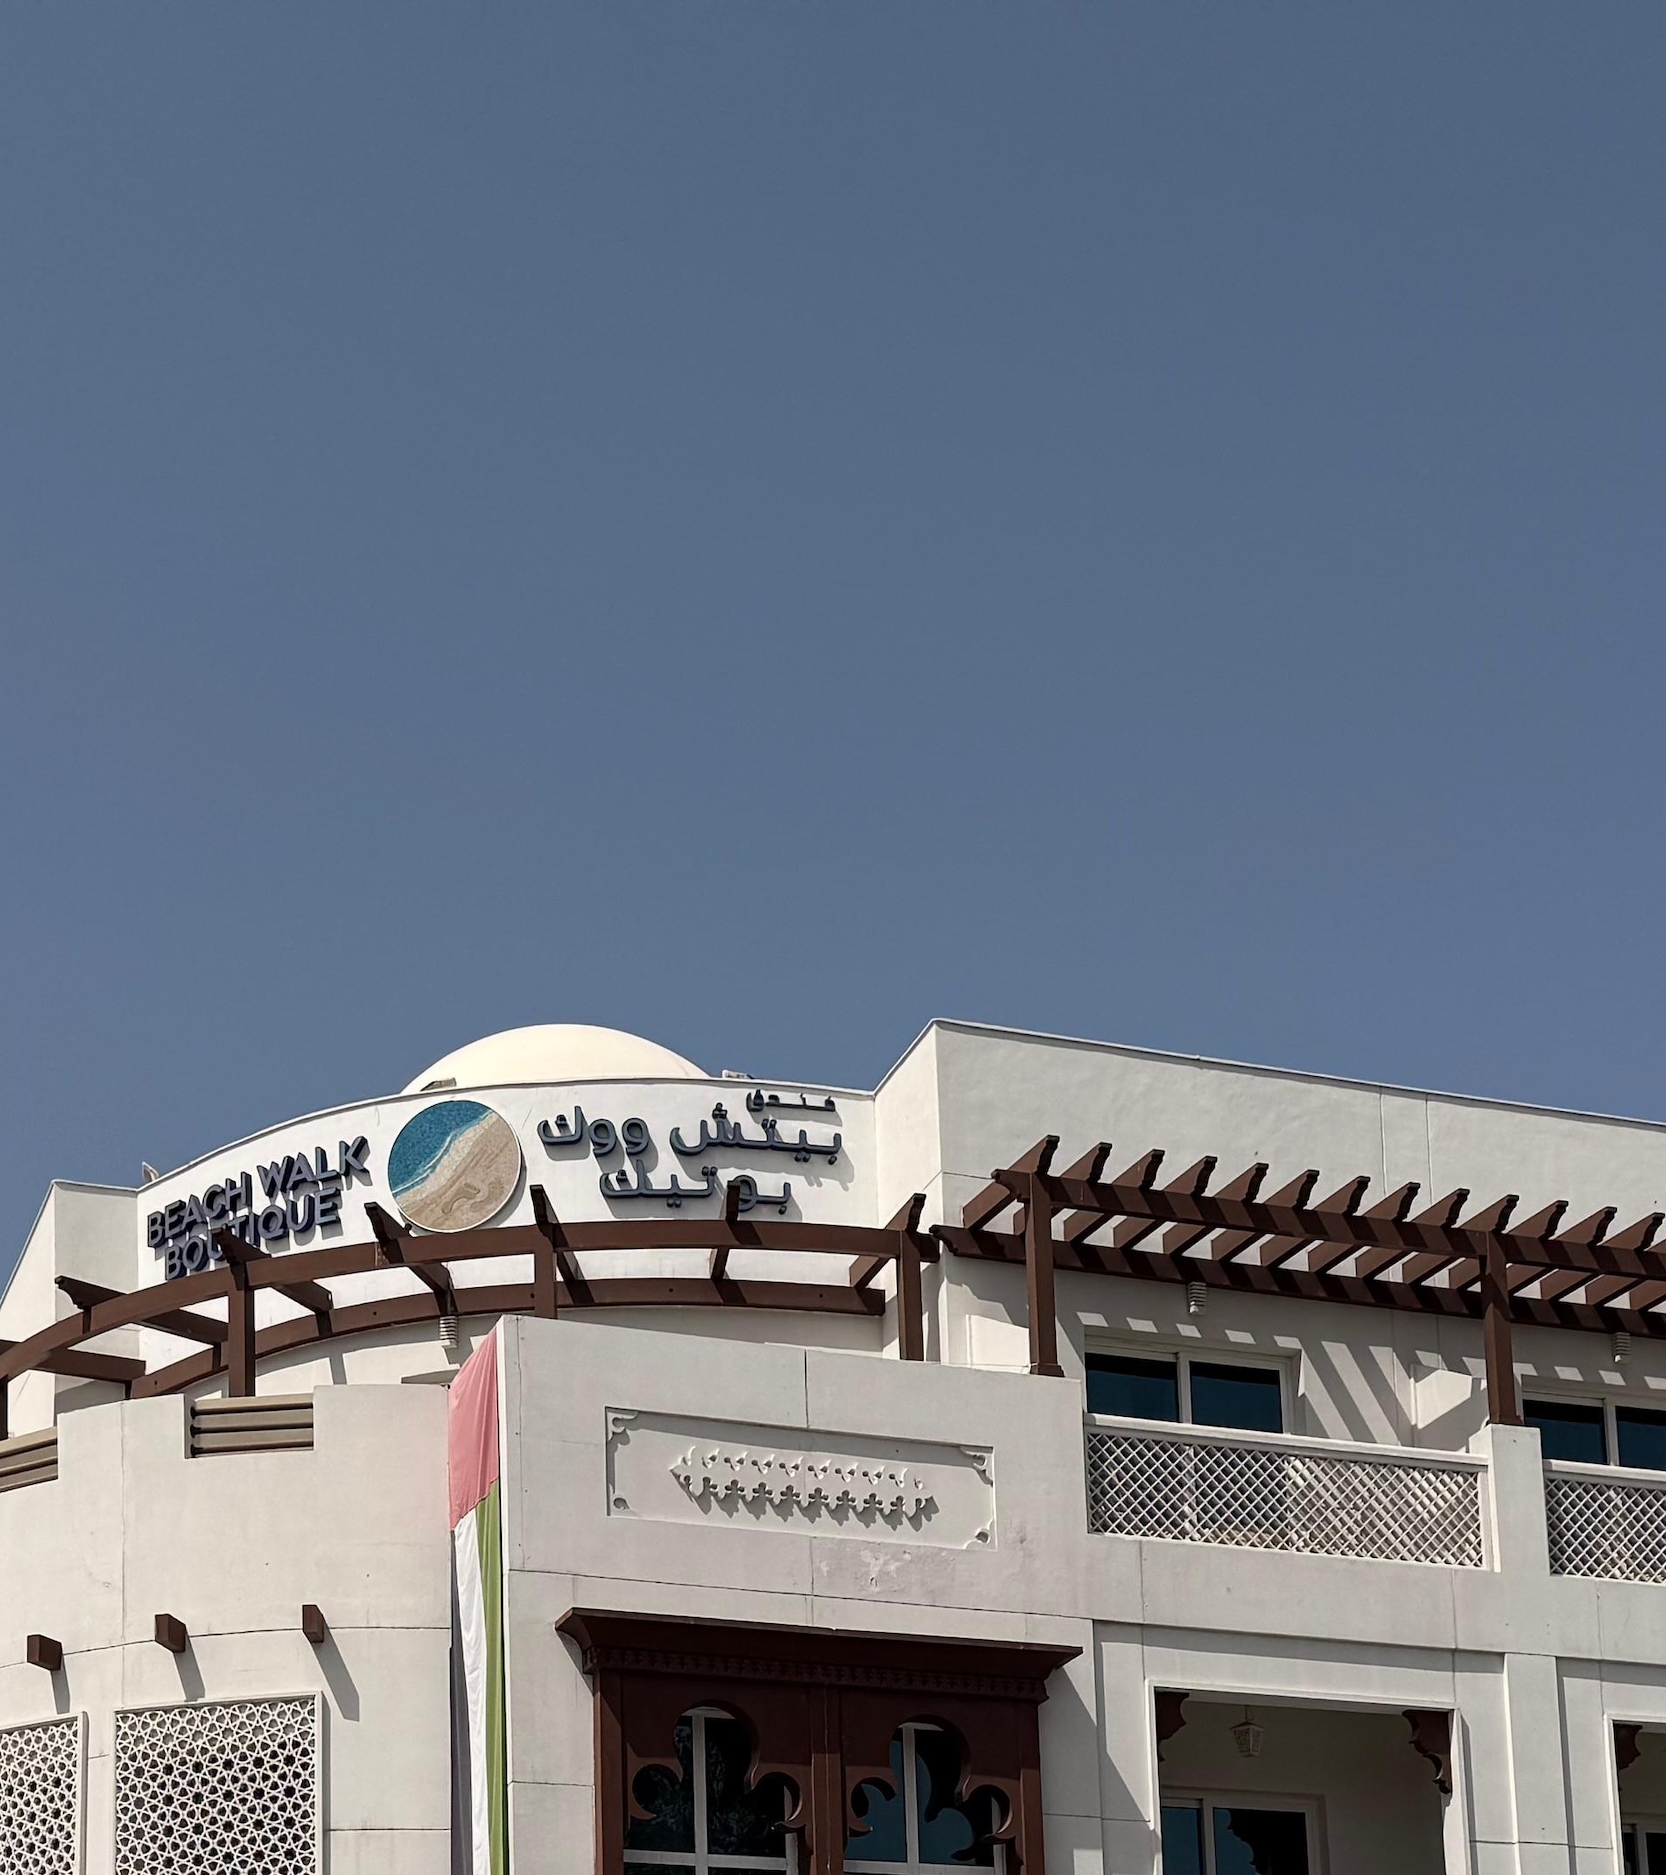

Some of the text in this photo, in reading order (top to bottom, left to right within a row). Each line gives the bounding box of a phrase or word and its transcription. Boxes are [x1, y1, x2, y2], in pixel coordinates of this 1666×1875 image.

[745, 1088, 836, 1113] فندق
[536, 1102, 842, 1166] بيتش ووك
[147, 1135, 371, 1248] BEACH WALK
[599, 1159, 792, 1213] بوتيك
